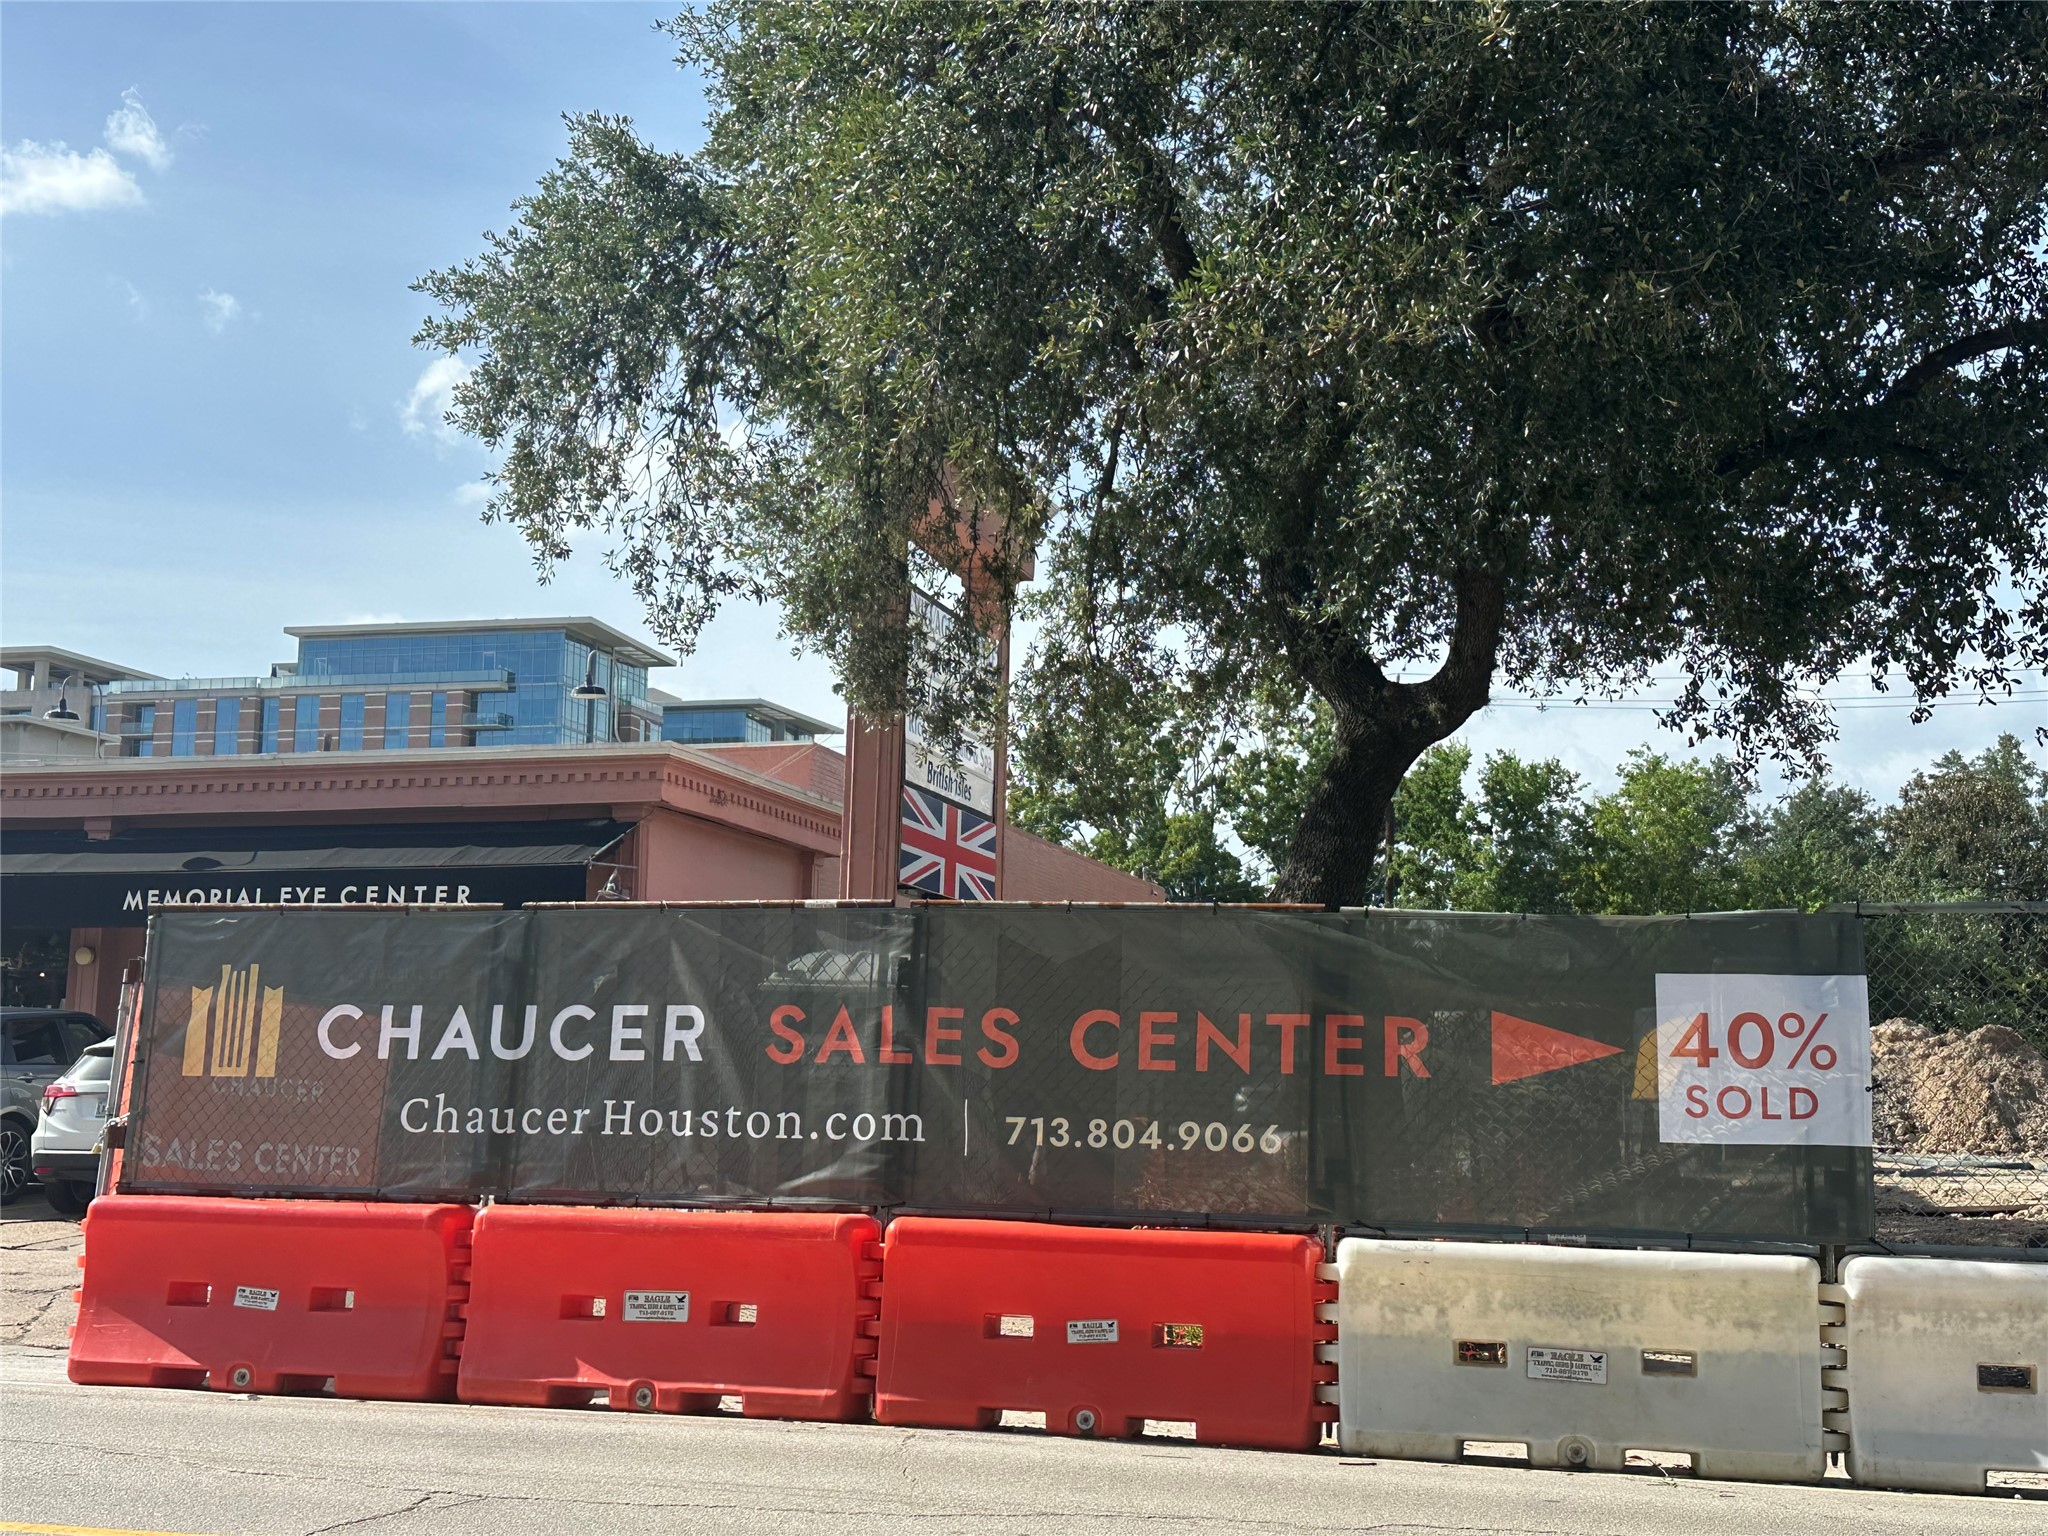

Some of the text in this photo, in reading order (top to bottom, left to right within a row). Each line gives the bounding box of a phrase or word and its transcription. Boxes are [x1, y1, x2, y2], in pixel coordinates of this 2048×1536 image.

[340, 884, 472, 905] CENTER
[317, 1003, 1432, 1079] CHAUCER SALES CENTER
[1669, 1011, 1837, 1071] 40%
[211, 1076, 325, 1102] CHAUCER
[1685, 1084, 1819, 1121] SOLD
[1005, 1115, 1283, 1155] 713.804.9066
[141, 1132, 361, 1177] SALES CENTER
[1550, 1351, 1584, 1362] EAGLE
